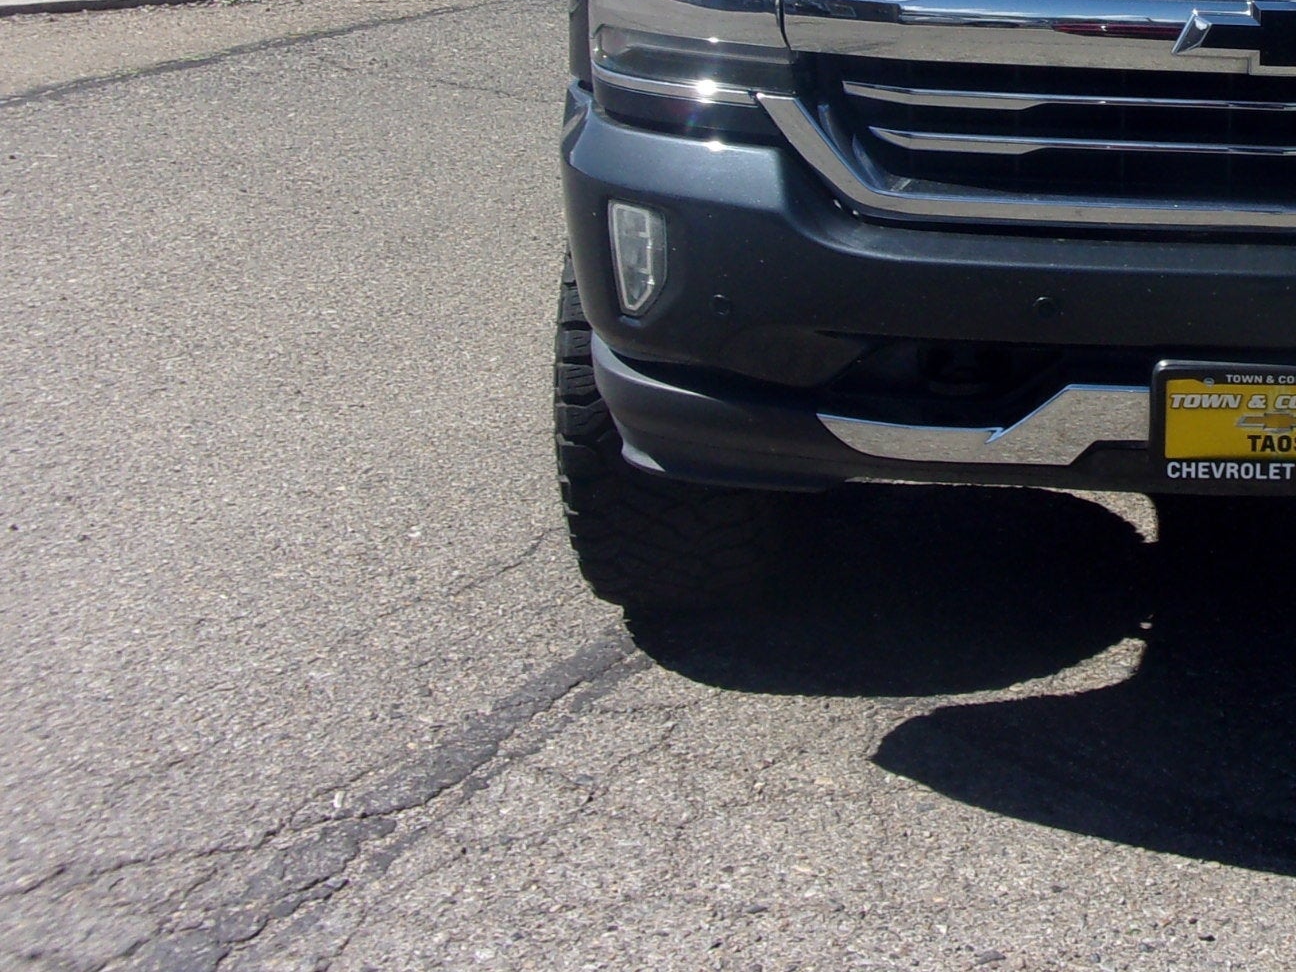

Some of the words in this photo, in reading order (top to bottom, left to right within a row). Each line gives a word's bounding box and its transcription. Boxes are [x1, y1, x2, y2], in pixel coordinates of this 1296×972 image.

[1226, 374, 1263, 384] TOWN
[1266, 375, 1274, 384] &
[1170, 393, 1242, 409] TOWN
[1247, 394, 1267, 409] &
[1166, 461, 1294, 480] CHEVROLET
